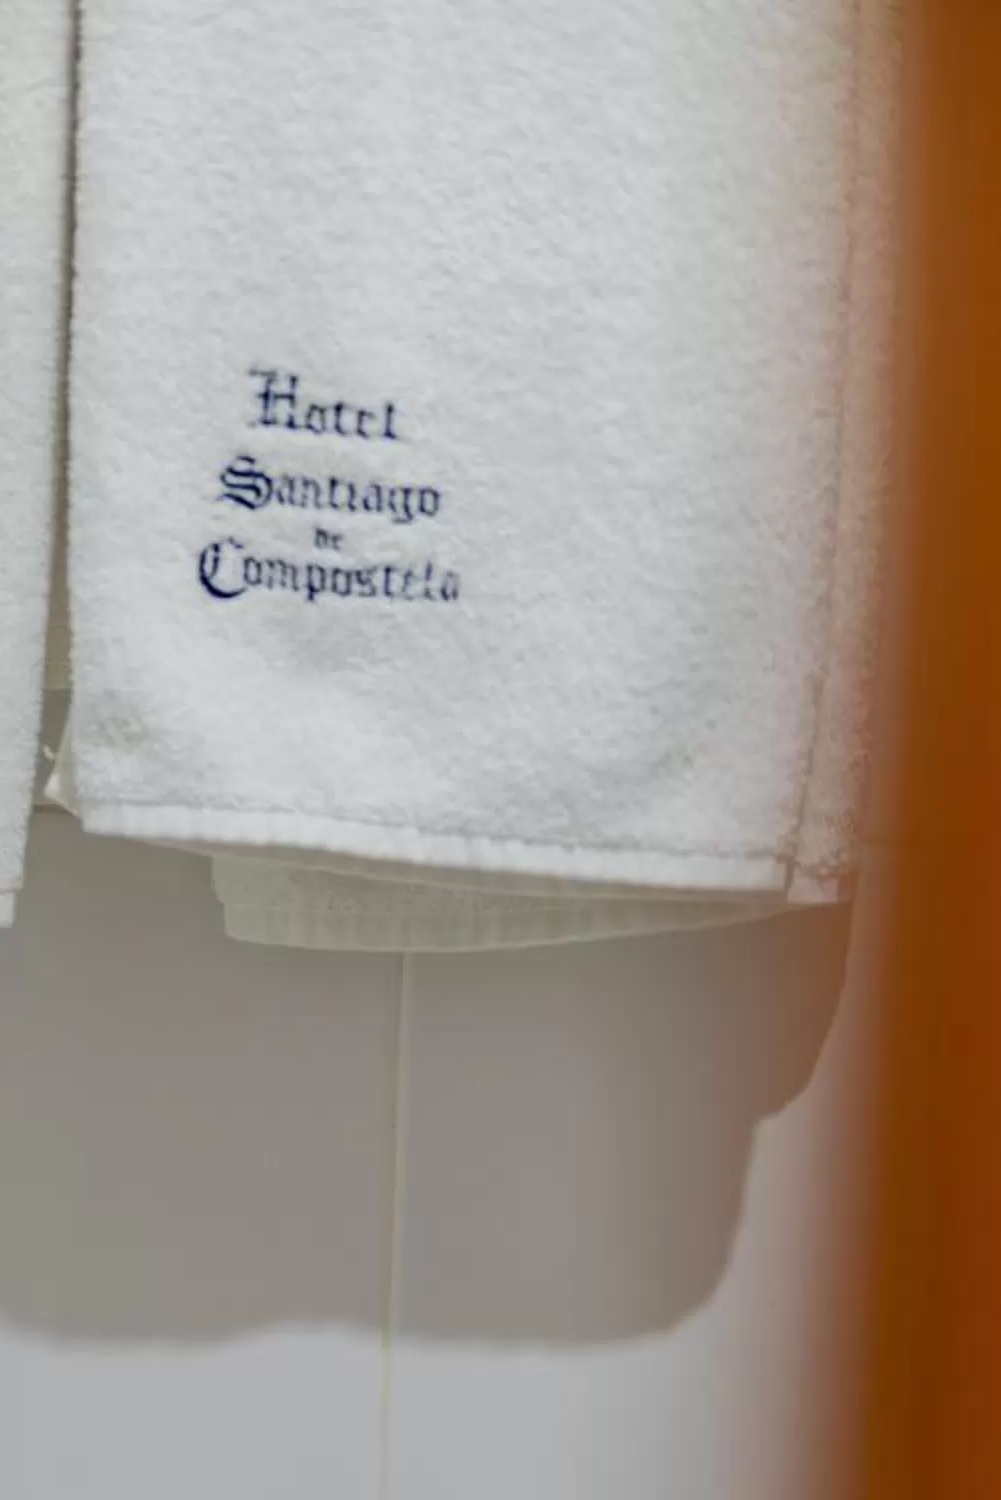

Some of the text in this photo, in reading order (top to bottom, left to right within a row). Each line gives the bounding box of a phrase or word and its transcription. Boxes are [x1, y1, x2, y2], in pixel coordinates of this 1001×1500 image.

[248, 367, 400, 441] Hotel
[216, 455, 441, 525] Santiago
[198, 537, 461, 603] Compostela
